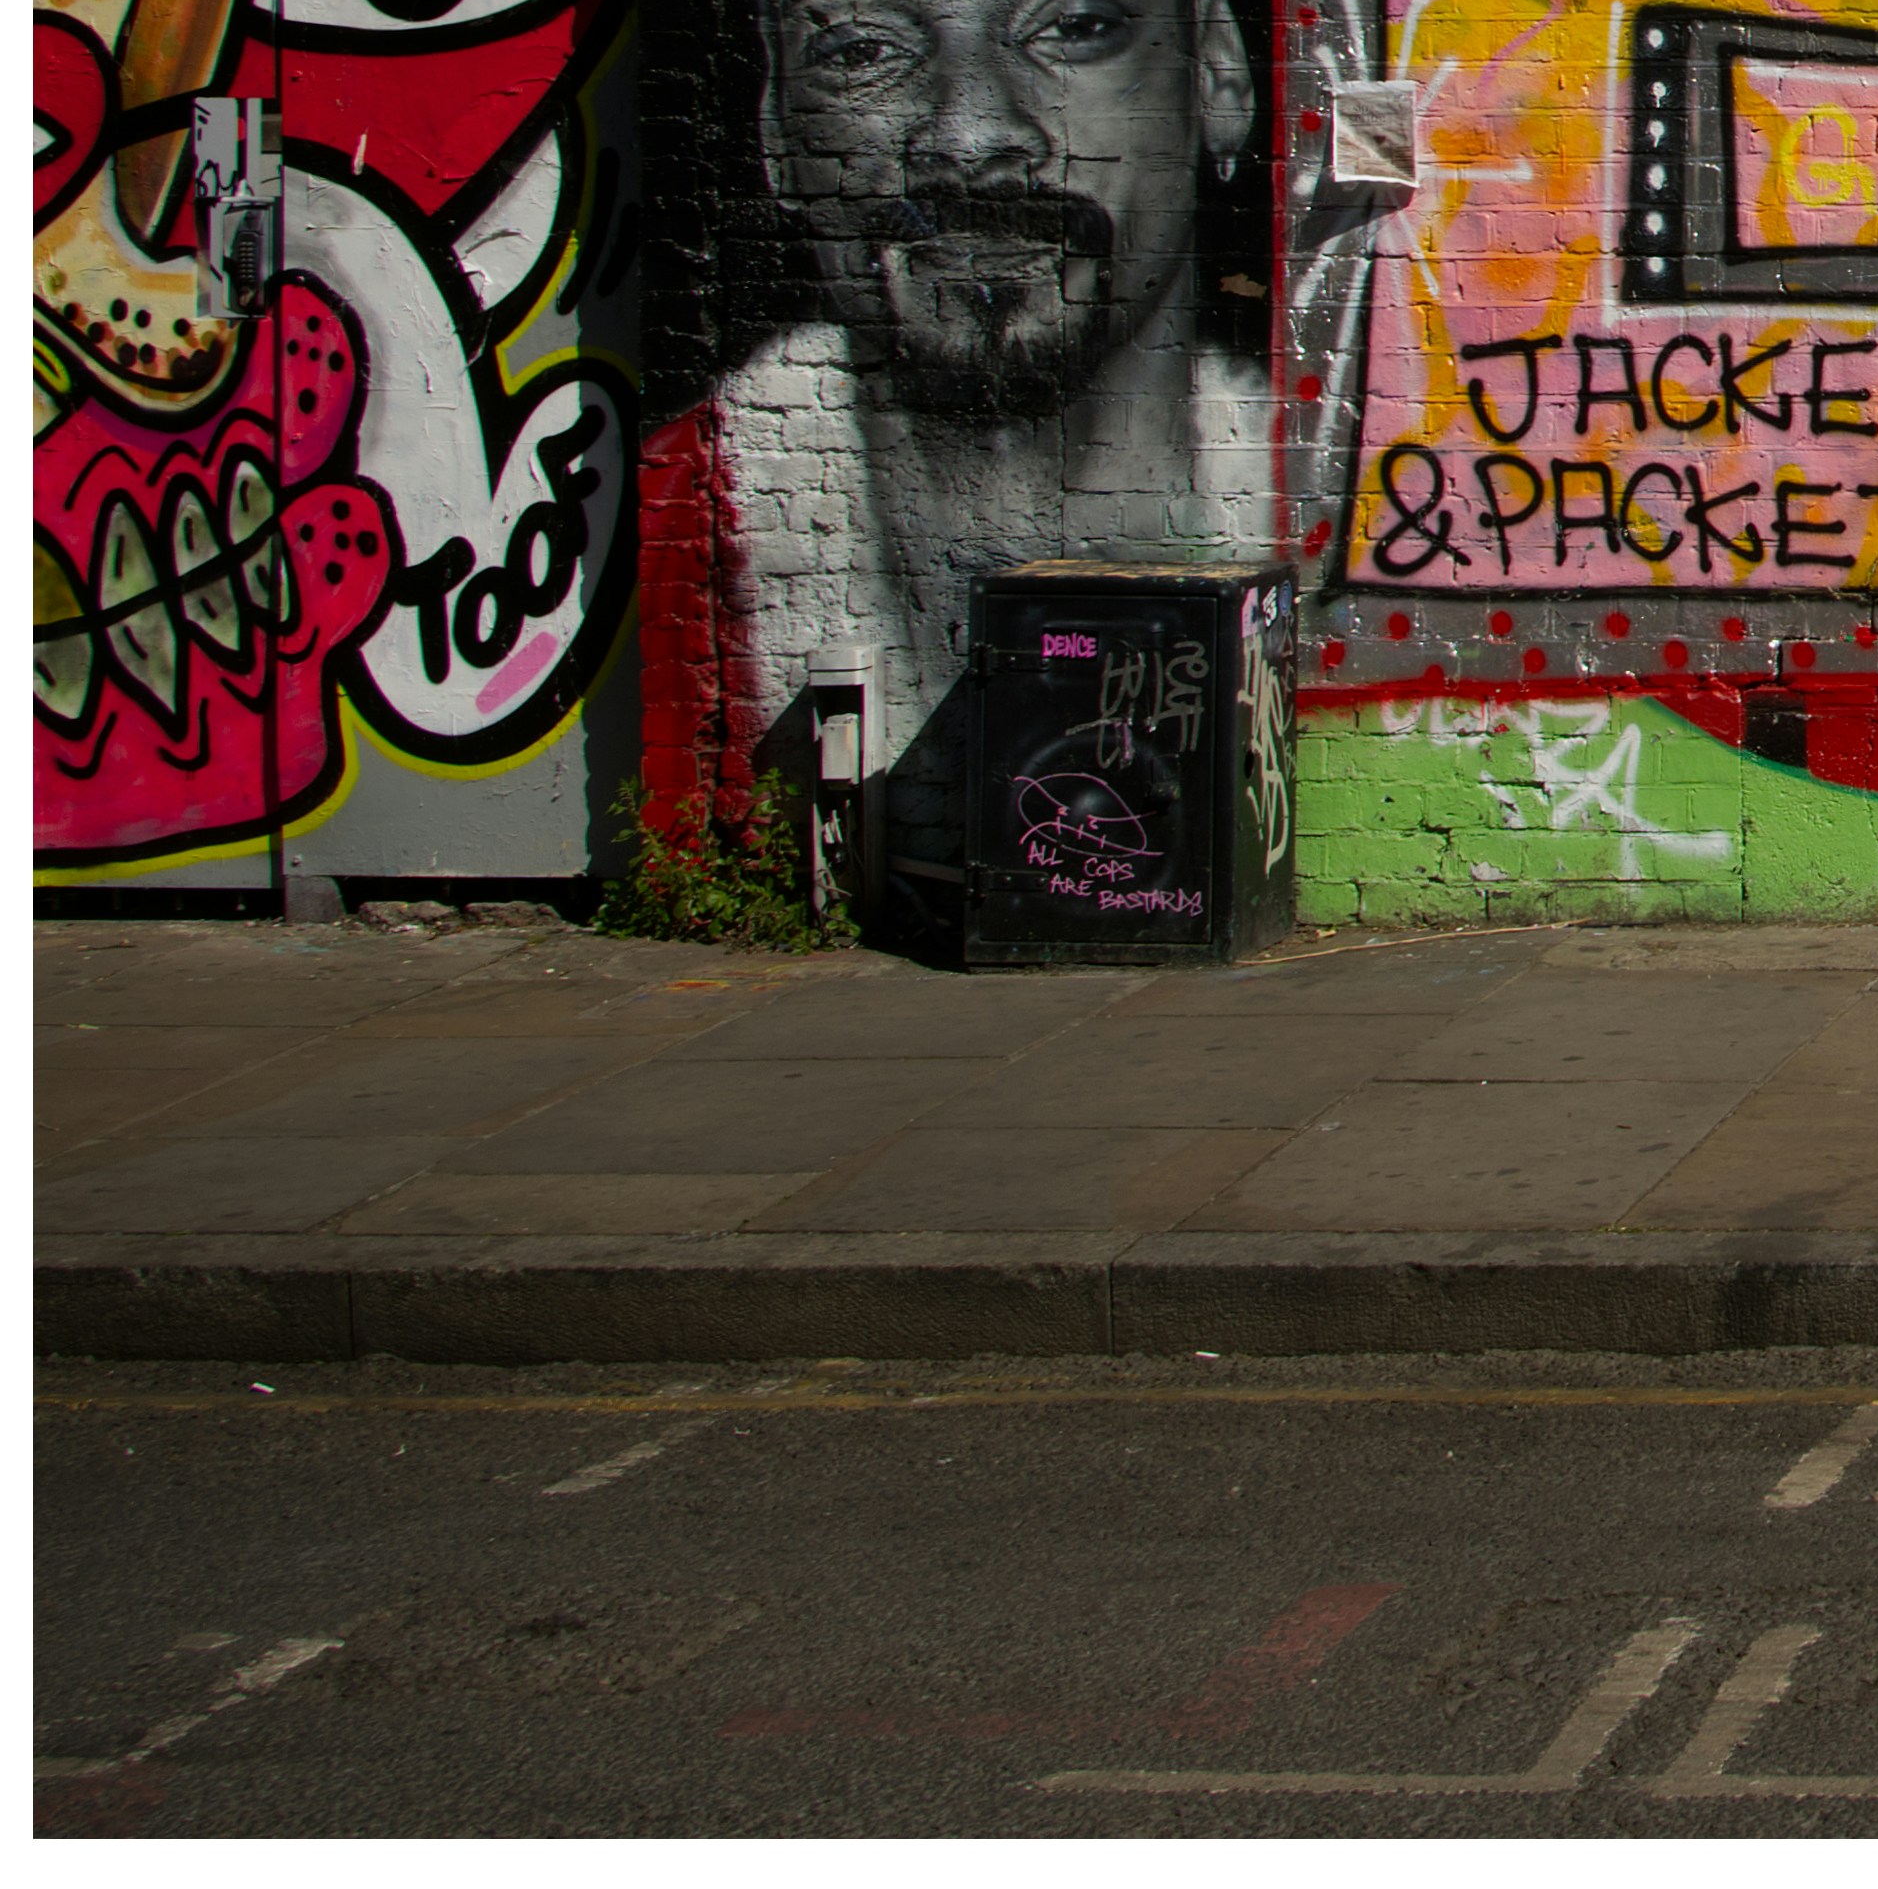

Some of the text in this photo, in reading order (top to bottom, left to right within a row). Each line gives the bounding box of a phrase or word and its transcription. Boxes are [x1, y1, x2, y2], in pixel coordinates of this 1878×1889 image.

[396, 405, 608, 685] TOOF
[1042, 633, 1097, 660] DENCE
[1026, 840, 1136, 884] ALL COPS
[1049, 872, 1094, 897] ARE
